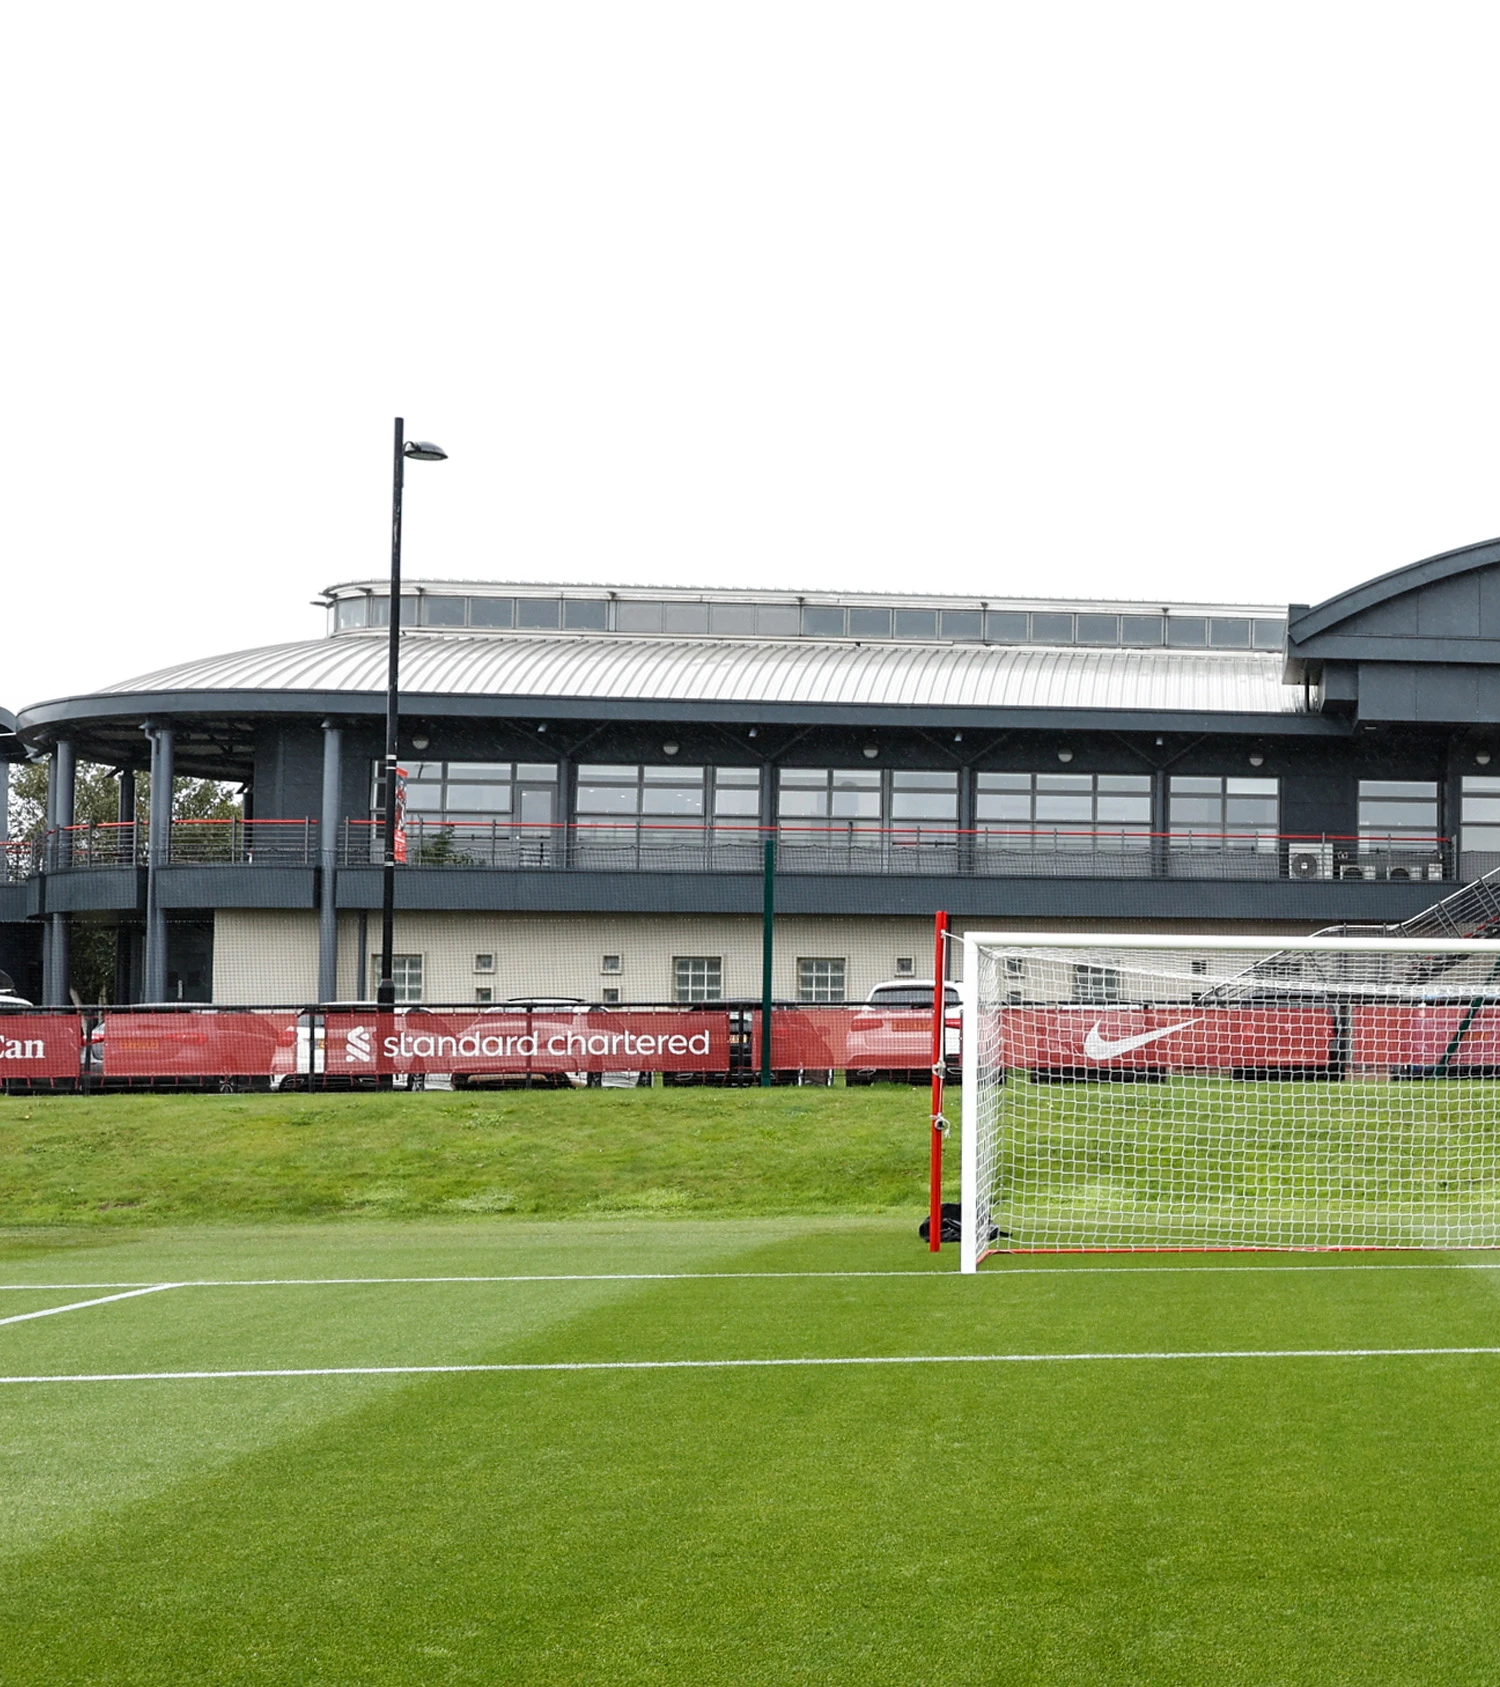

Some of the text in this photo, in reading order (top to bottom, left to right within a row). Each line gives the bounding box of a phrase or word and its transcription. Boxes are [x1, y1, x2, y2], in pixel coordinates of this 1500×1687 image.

[0, 1035, 46, 1059] an
[382, 1029, 711, 1058] standard chartered
